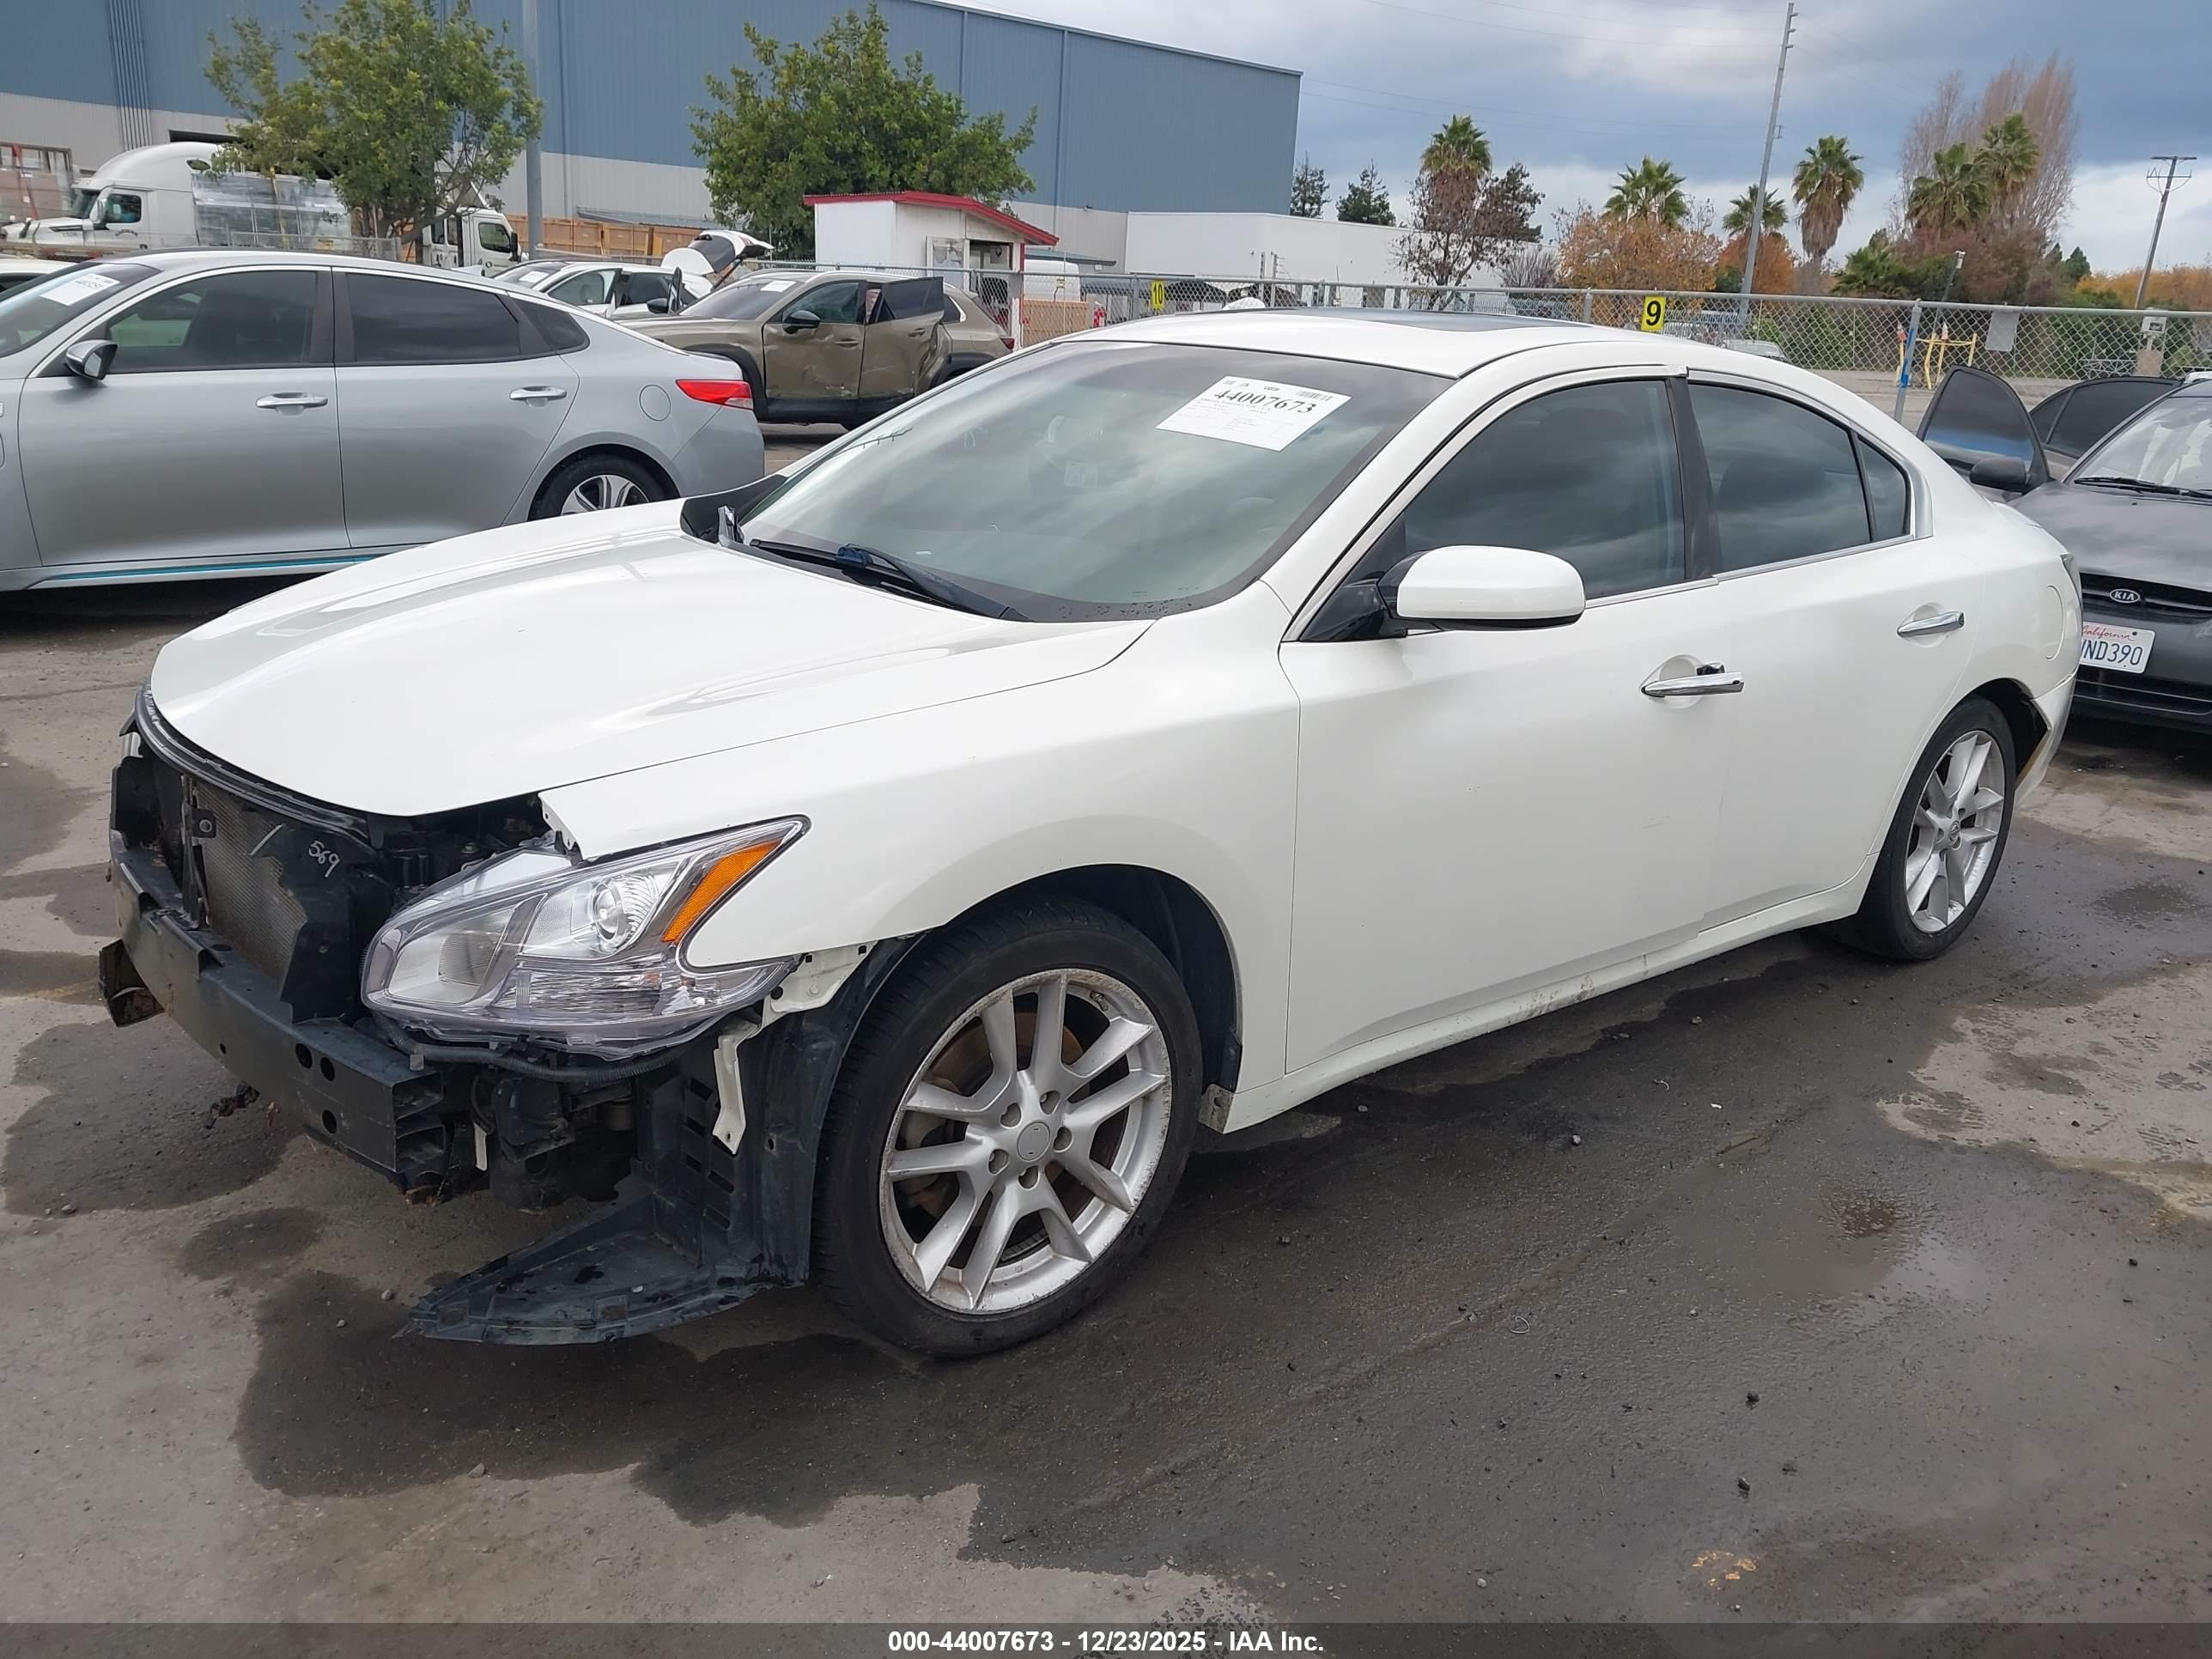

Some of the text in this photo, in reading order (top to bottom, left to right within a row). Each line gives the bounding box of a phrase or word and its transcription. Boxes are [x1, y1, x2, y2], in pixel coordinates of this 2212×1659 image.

[1153, 283, 1163, 304] 10
[1646, 301, 1662, 325] 9
[1214, 390, 1317, 414] 44007673
[2114, 591, 2135, 601] KIA
[309, 840, 340, 878] 569
